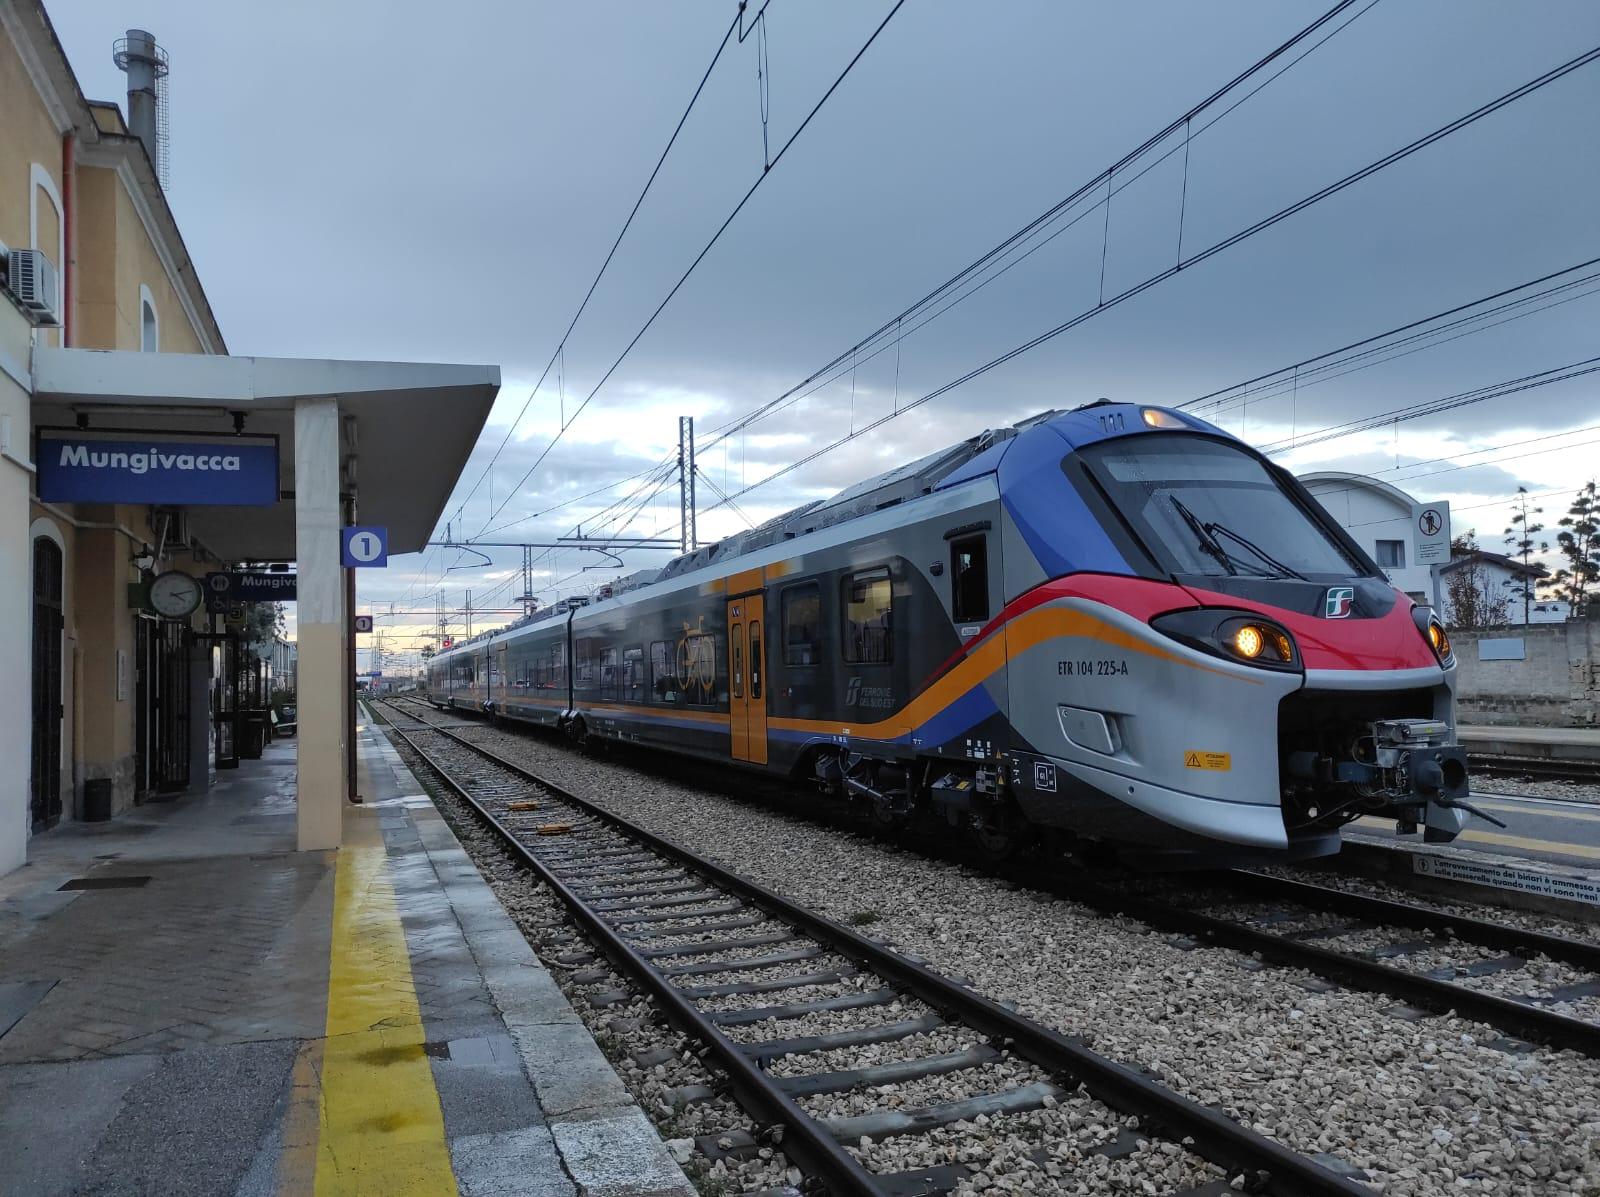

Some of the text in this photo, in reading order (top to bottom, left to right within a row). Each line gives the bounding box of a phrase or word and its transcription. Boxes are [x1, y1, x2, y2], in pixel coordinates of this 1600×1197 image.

[59, 445, 241, 475] Mungivacca
[361, 537, 370, 556] 1
[1057, 660, 1129, 676] ETR 104 225-A
[1434, 859, 1502, 877] L'attraversamento
[1502, 870, 1516, 879] dei
[1517, 871, 1543, 884] binari
[1552, 879, 1594, 892] ammesso
[1434, 868, 1598, 901] sulla passerella quando non vi sono treni
